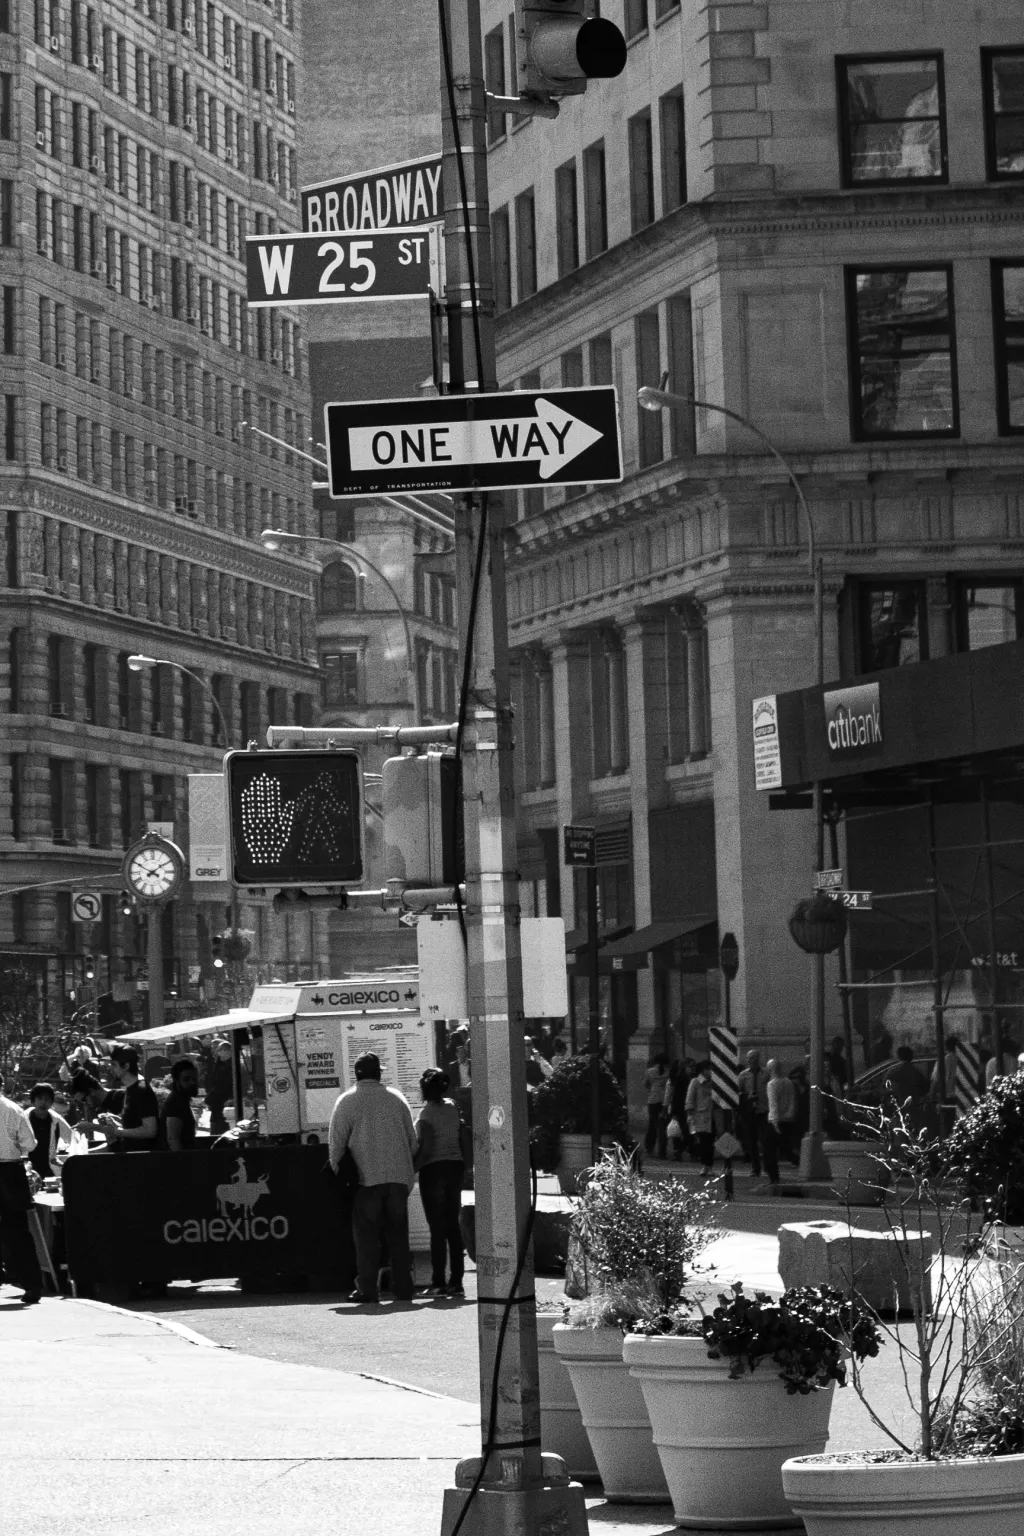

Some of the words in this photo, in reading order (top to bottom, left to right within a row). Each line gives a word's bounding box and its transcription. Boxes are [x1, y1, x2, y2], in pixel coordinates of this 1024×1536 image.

[308, 165, 442, 232] BROADWAY
[258, 244, 294, 295] W
[317, 241, 377, 293] 25
[398, 238, 425, 265] ST
[372, 427, 453, 465] ONE
[490, 421, 573, 458] WAY
[387, 481, 452, 489] TRANSPORTATION
[828, 704, 882, 750] citibank
[196, 868, 222, 876] GREY
[843, 893, 857, 907] 24
[328, 990, 400, 1005] calexico
[369, 1023, 403, 1031] calexico
[306, 1052, 334, 1061] VENDY
[307, 1060, 335, 1068] AWARD
[307, 1068, 335, 1076] WINNER
[164, 1215, 289, 1244] calexico
